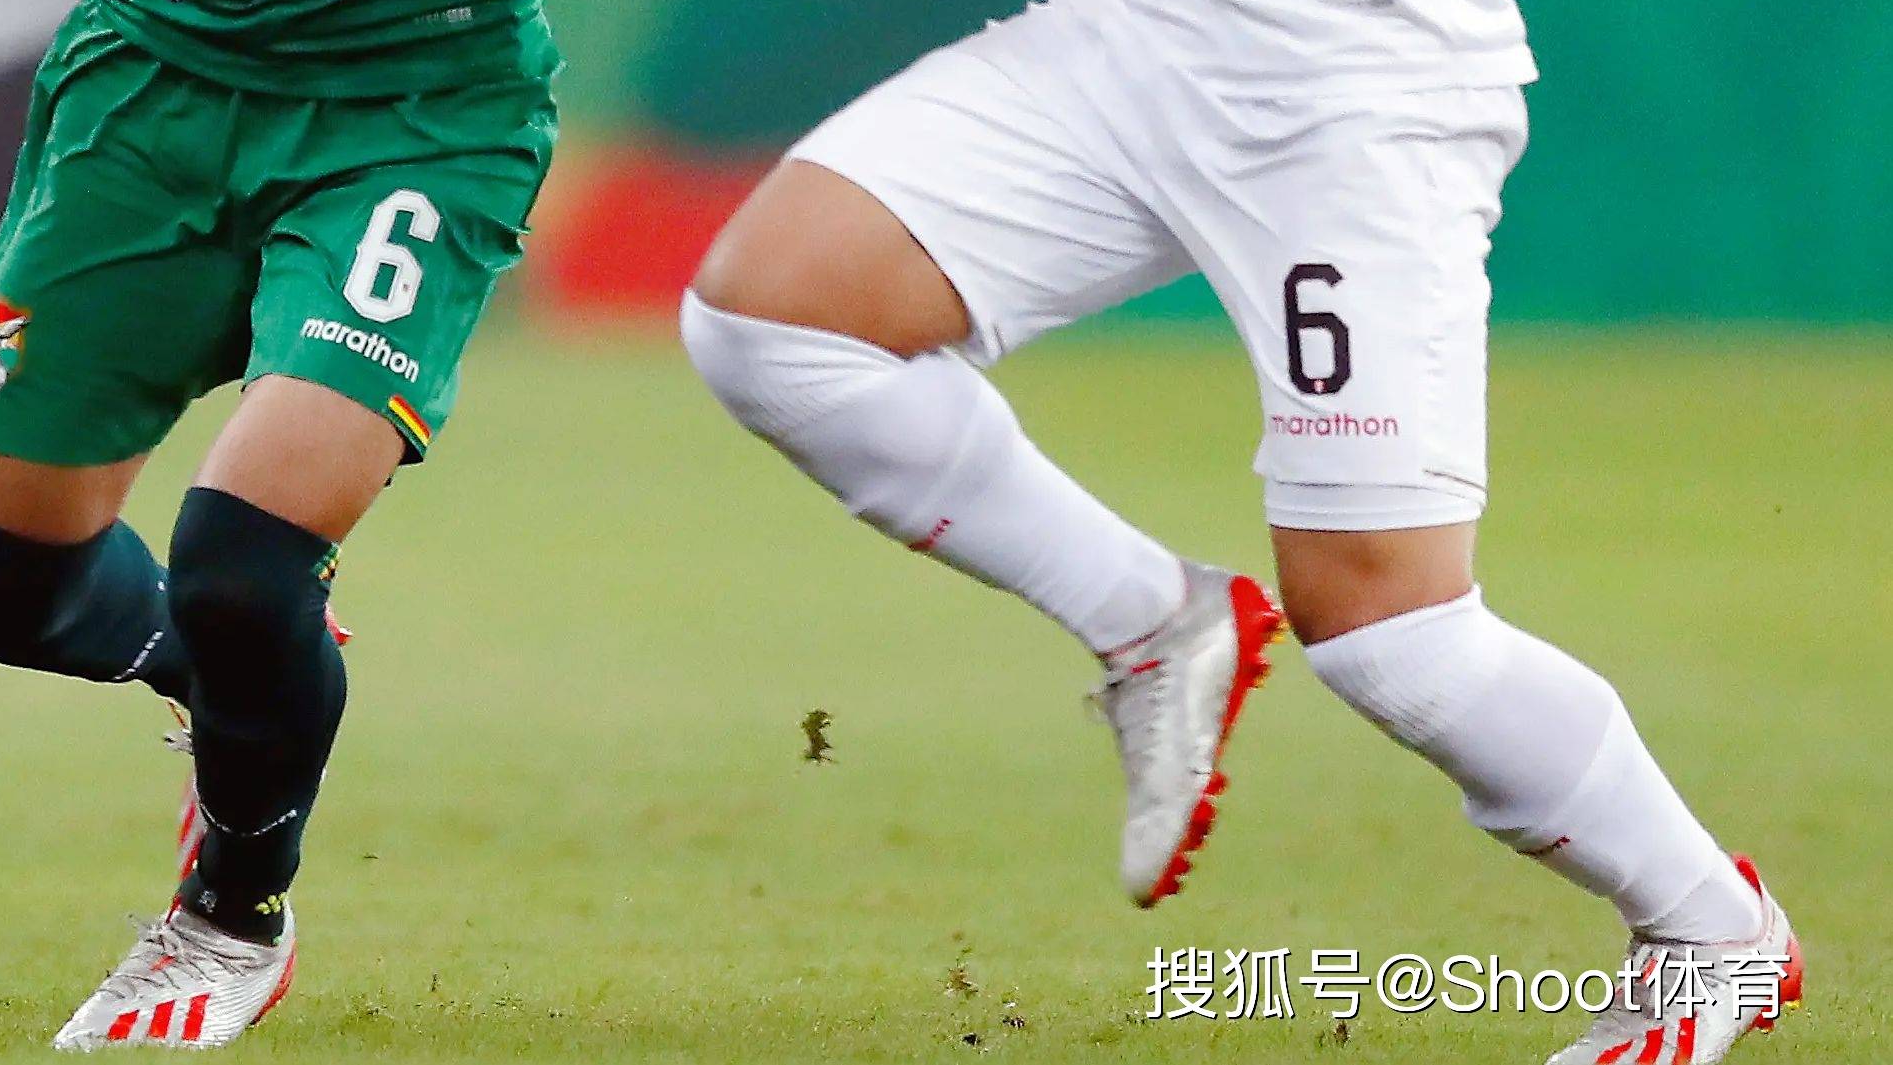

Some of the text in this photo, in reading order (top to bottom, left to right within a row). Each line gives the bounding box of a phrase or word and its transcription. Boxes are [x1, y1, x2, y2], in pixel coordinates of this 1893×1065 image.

[343, 189, 441, 323] 6
[300, 317, 420, 383] marathon
[1284, 263, 1351, 395] 6
[1272, 413, 1399, 437] marathon
